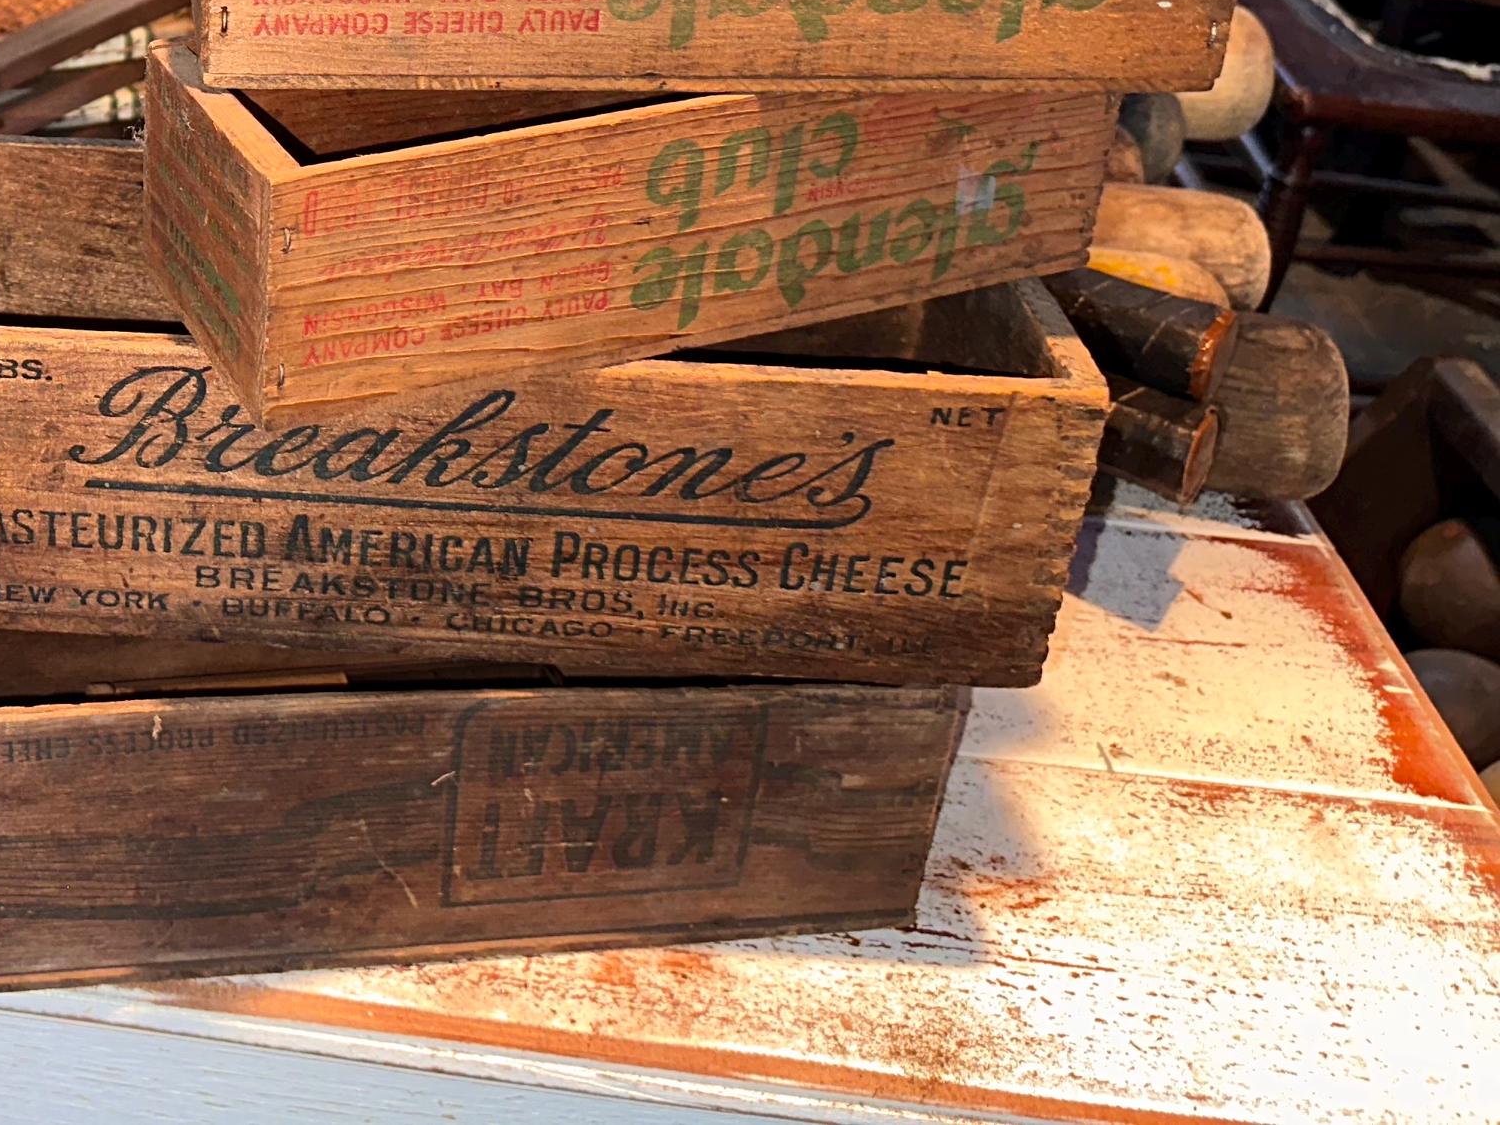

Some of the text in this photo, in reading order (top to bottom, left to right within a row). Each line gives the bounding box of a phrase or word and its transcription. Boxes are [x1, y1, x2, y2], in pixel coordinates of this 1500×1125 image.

[253, 10, 600, 37] PAULY CHEESE COMPANY
[647, 111, 858, 232] club
[630, 140, 1041, 331] glendale
[302, 291, 609, 368] PAULY CHEESE COMPANY
[303, 292, 445, 336] WISCONSIN
[68, 365, 895, 509] Breakstone's
[930, 406, 1009, 427] NET
[283, 513, 528, 578] AMERICAN
[551, 530, 761, 589] PROCESS
[781, 542, 969, 599] CHEESE
[73, 587, 168, 612] YORK
[221, 597, 391, 625] BUFFALO
[446, 611, 614, 640] CHICAGO
[194, 565, 492, 608] BREAKSTONE
[89, 729, 215, 758] PROCESS
[488, 718, 735, 777] AMERICAN
[466, 794, 722, 880] KRAFT
